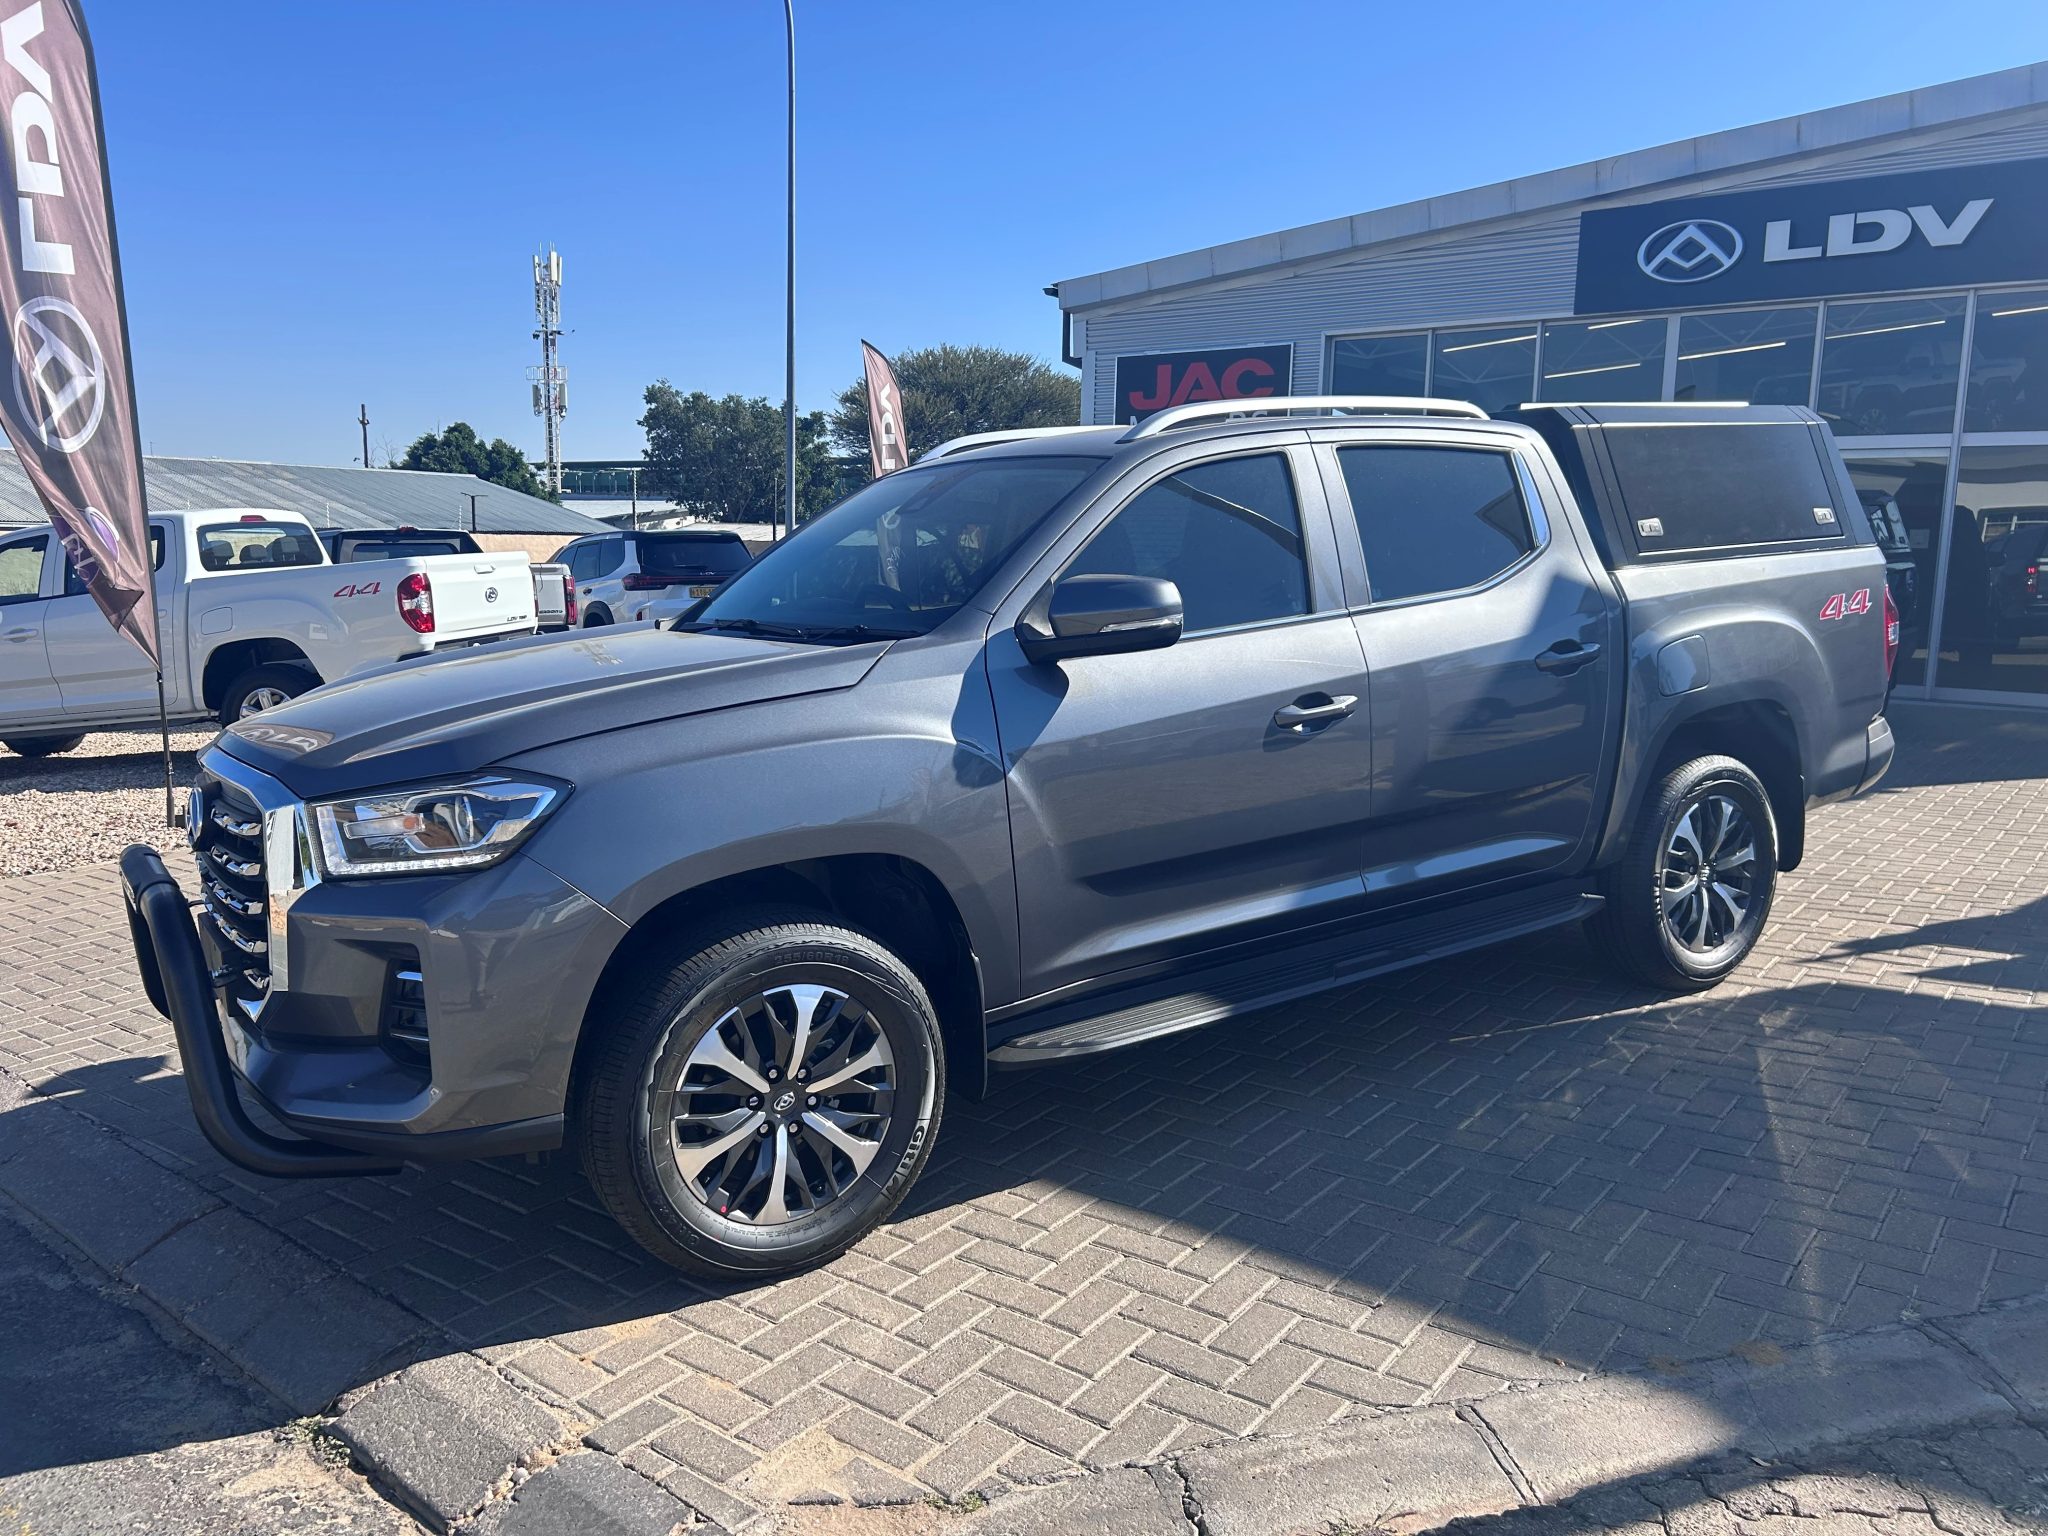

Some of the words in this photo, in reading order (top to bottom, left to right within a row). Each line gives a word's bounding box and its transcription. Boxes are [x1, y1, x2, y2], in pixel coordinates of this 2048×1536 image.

[0, 0, 76, 275] LDV
[1763, 198, 1995, 263] LDV
[1129, 358, 1276, 411] JAC
[880, 382, 896, 470] LDV
[333, 581, 382, 598] 4x4
[1819, 588, 1873, 620] 4x4
